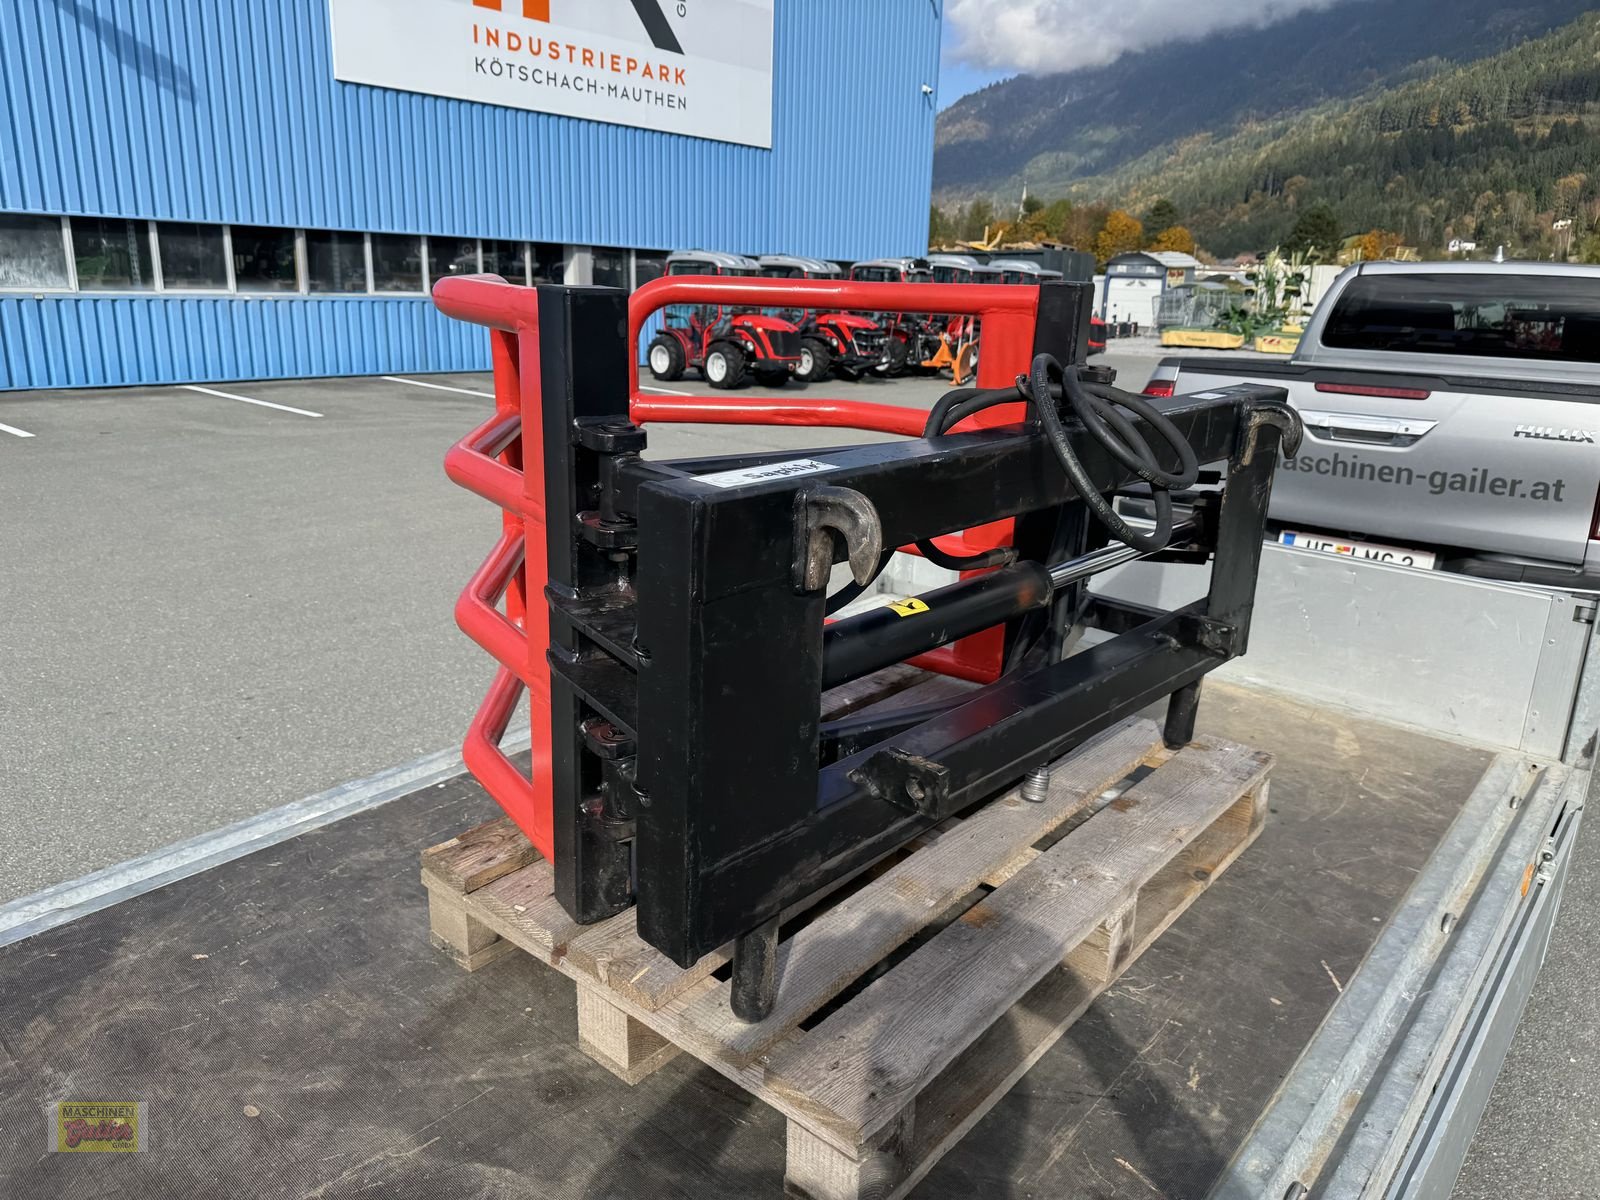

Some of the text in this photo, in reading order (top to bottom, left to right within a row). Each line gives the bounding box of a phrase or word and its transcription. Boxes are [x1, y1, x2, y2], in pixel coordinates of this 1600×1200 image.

[472, 23, 687, 86] INDUSTRIEPARK
[474, 56, 687, 110] KÖTSCHACH-MAUTHEN
[1513, 424, 1597, 443] HILUX
